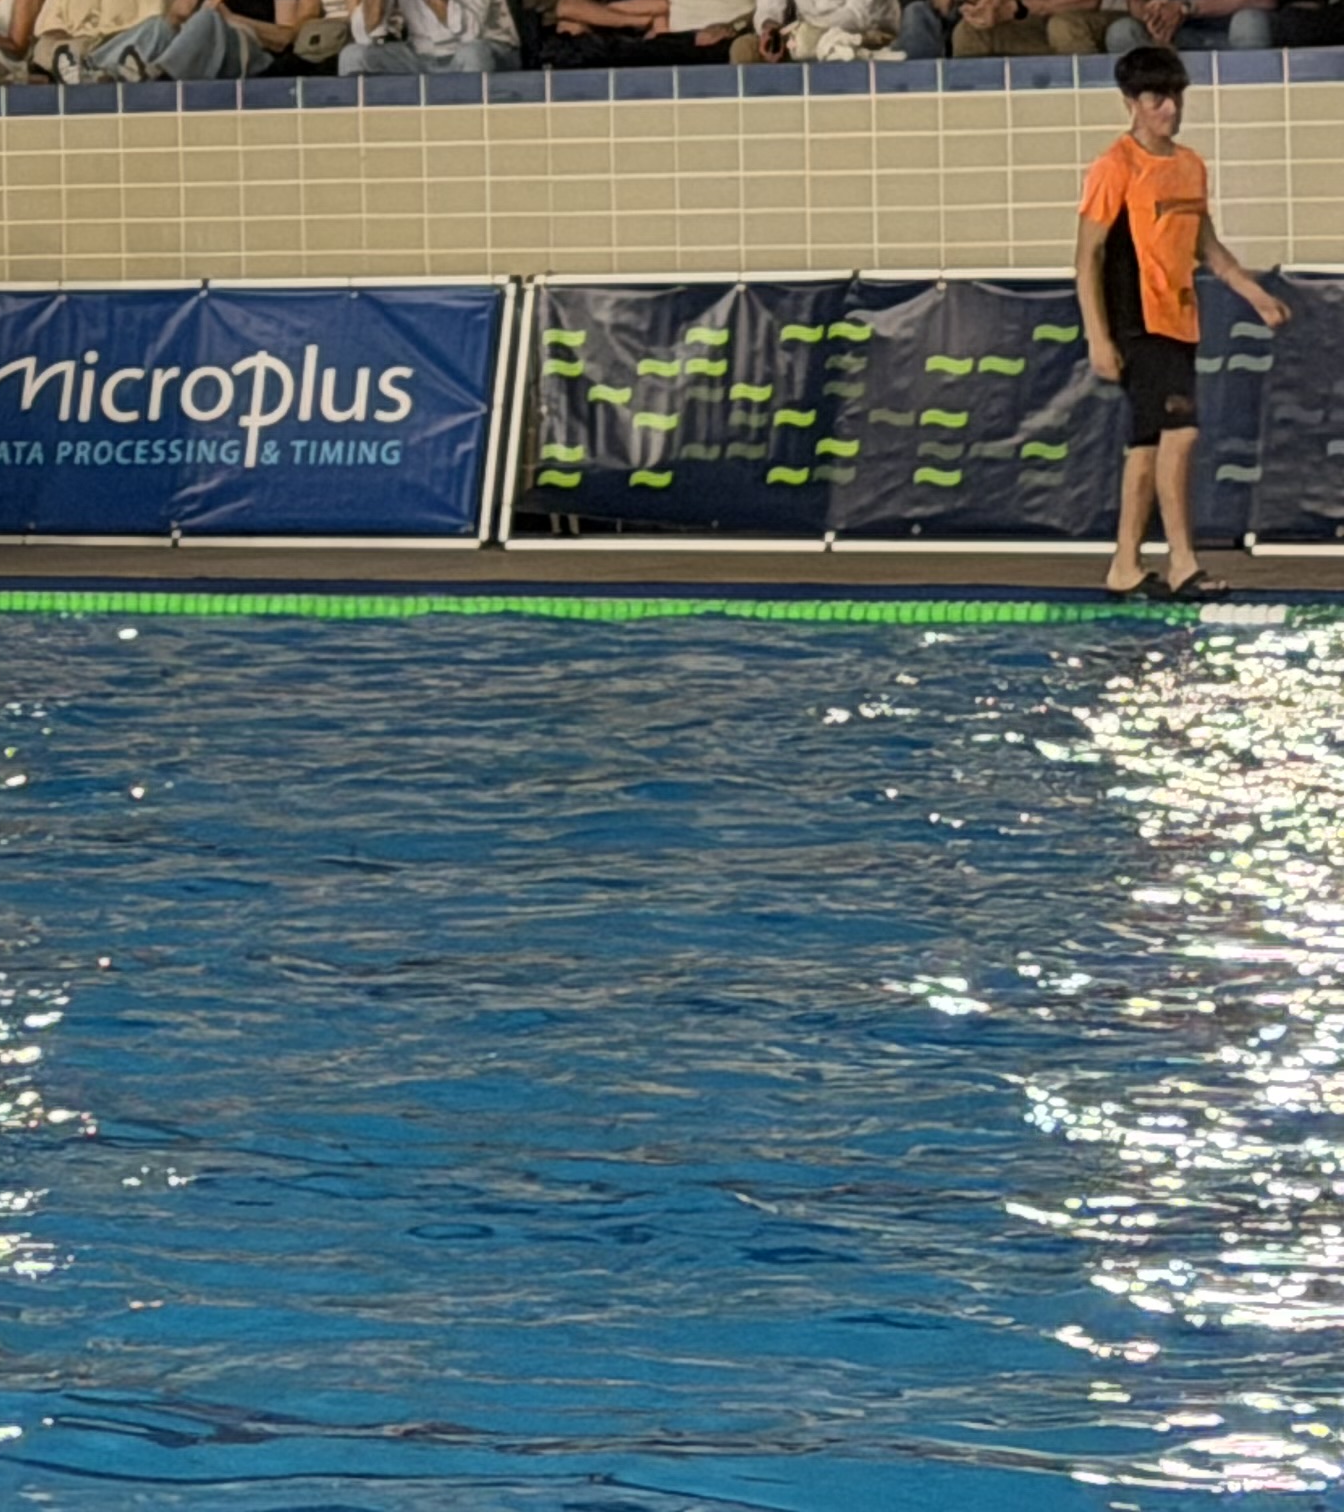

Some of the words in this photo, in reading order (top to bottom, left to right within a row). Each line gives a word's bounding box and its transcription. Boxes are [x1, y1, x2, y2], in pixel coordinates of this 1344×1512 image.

[55, 439, 241, 465] PROCESSING
[260, 439, 281, 465] &
[289, 439, 402, 465] TIMING
